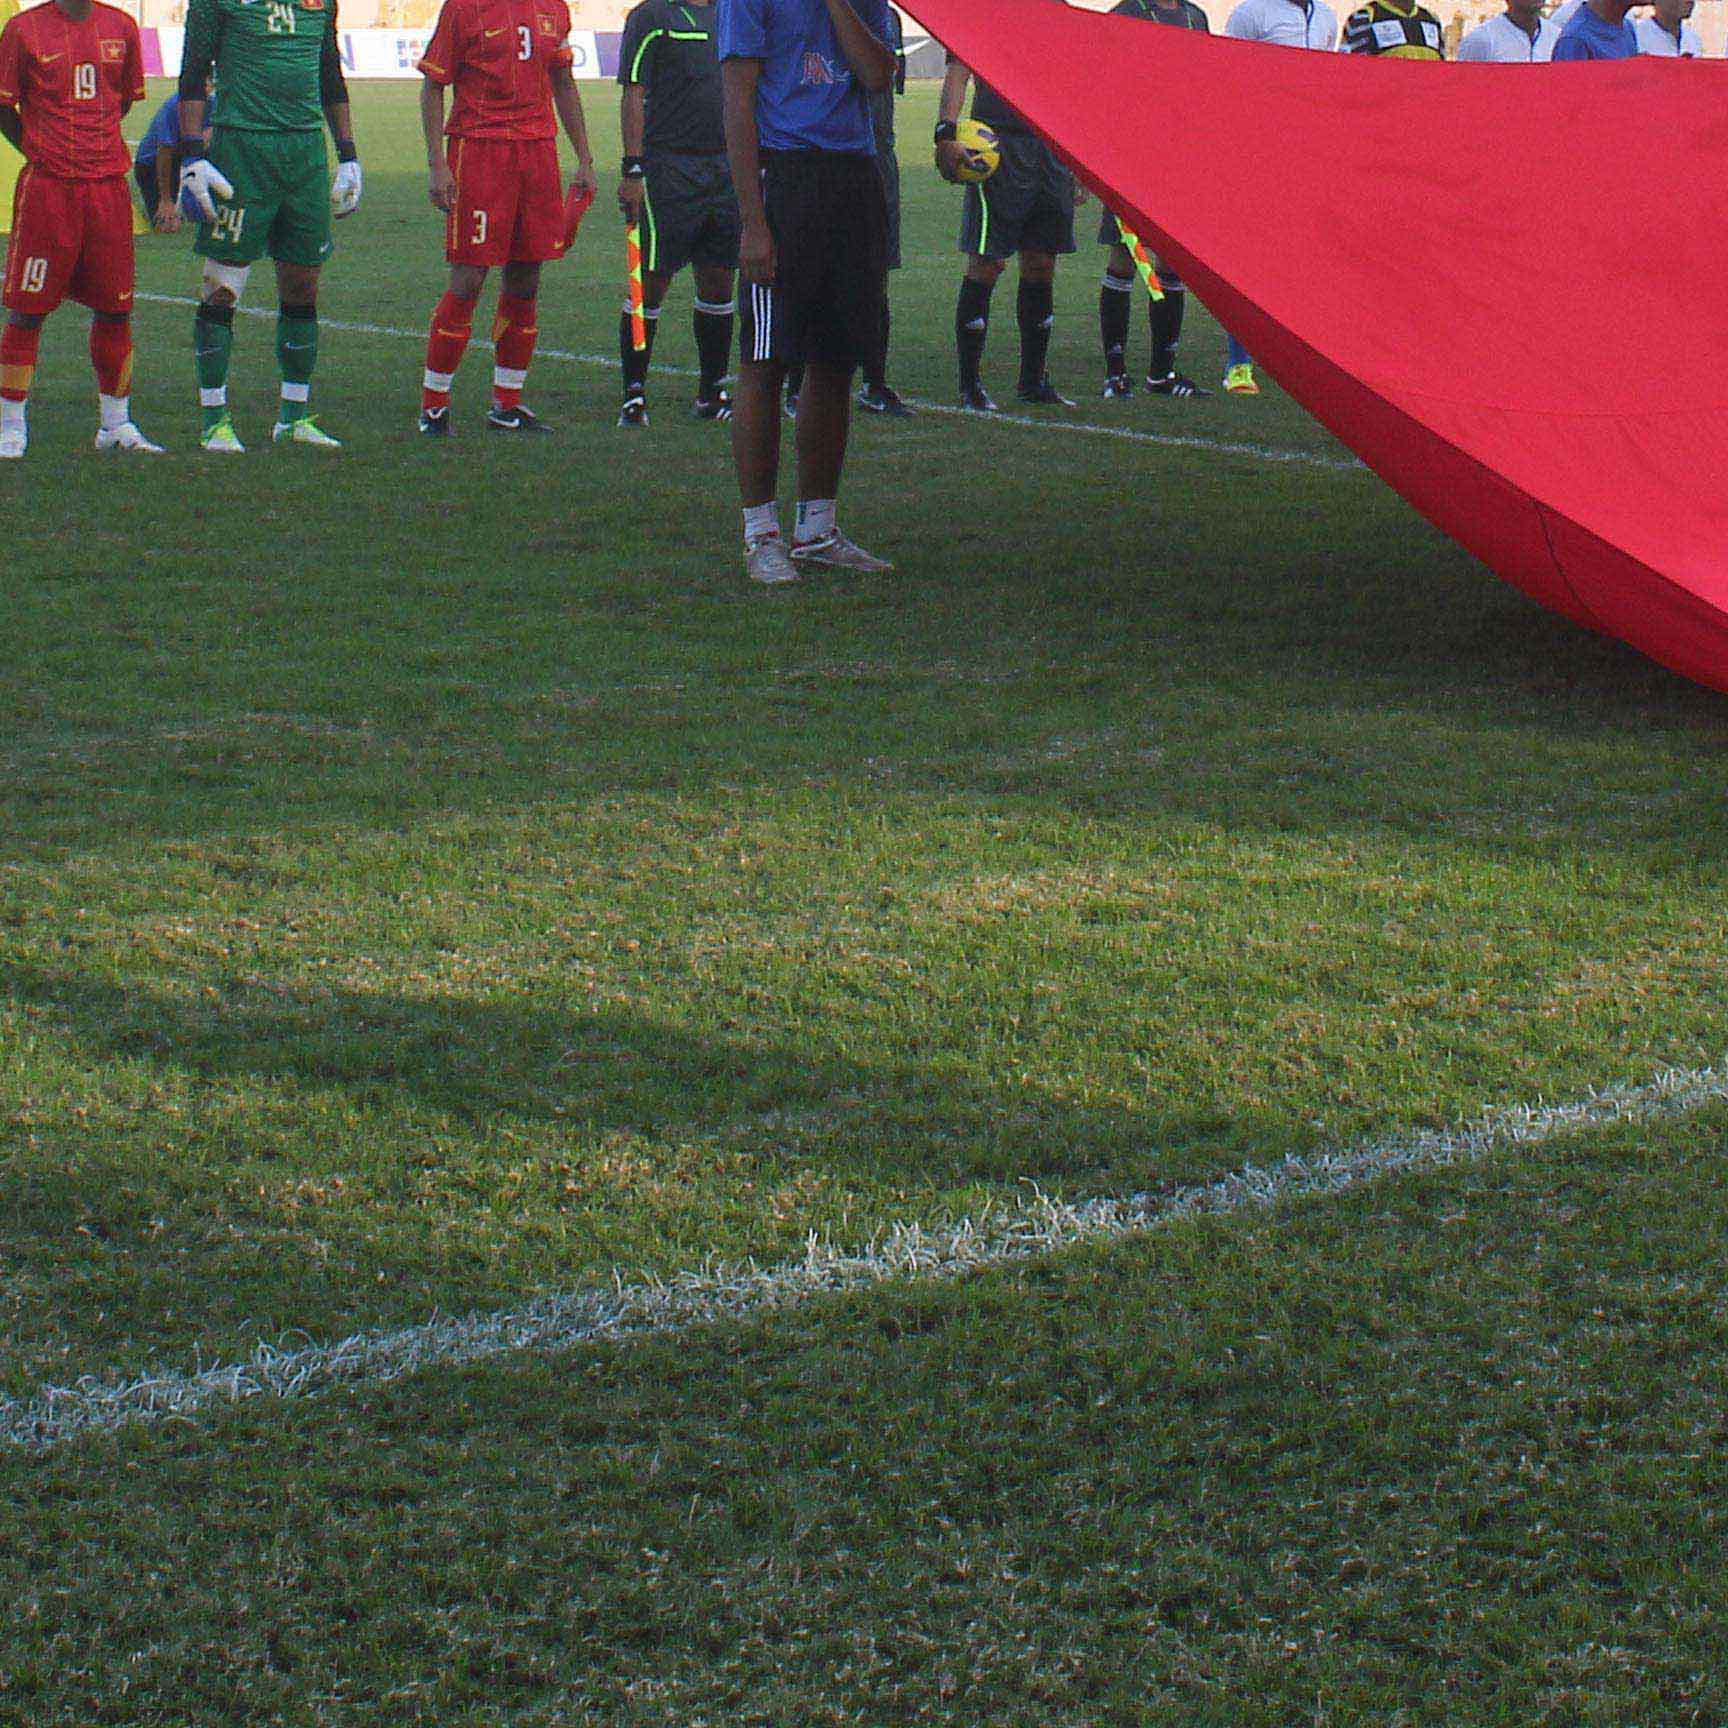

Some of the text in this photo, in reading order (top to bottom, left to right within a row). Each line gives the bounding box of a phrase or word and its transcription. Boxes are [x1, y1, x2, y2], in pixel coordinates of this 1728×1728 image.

[266, 1, 297, 34] 24
[517, 25, 531, 61] 3
[73, 63, 96, 100] 19
[212, 208, 244, 243] 24
[472, 209, 486, 244] 3
[21, 257, 48, 293] 19
